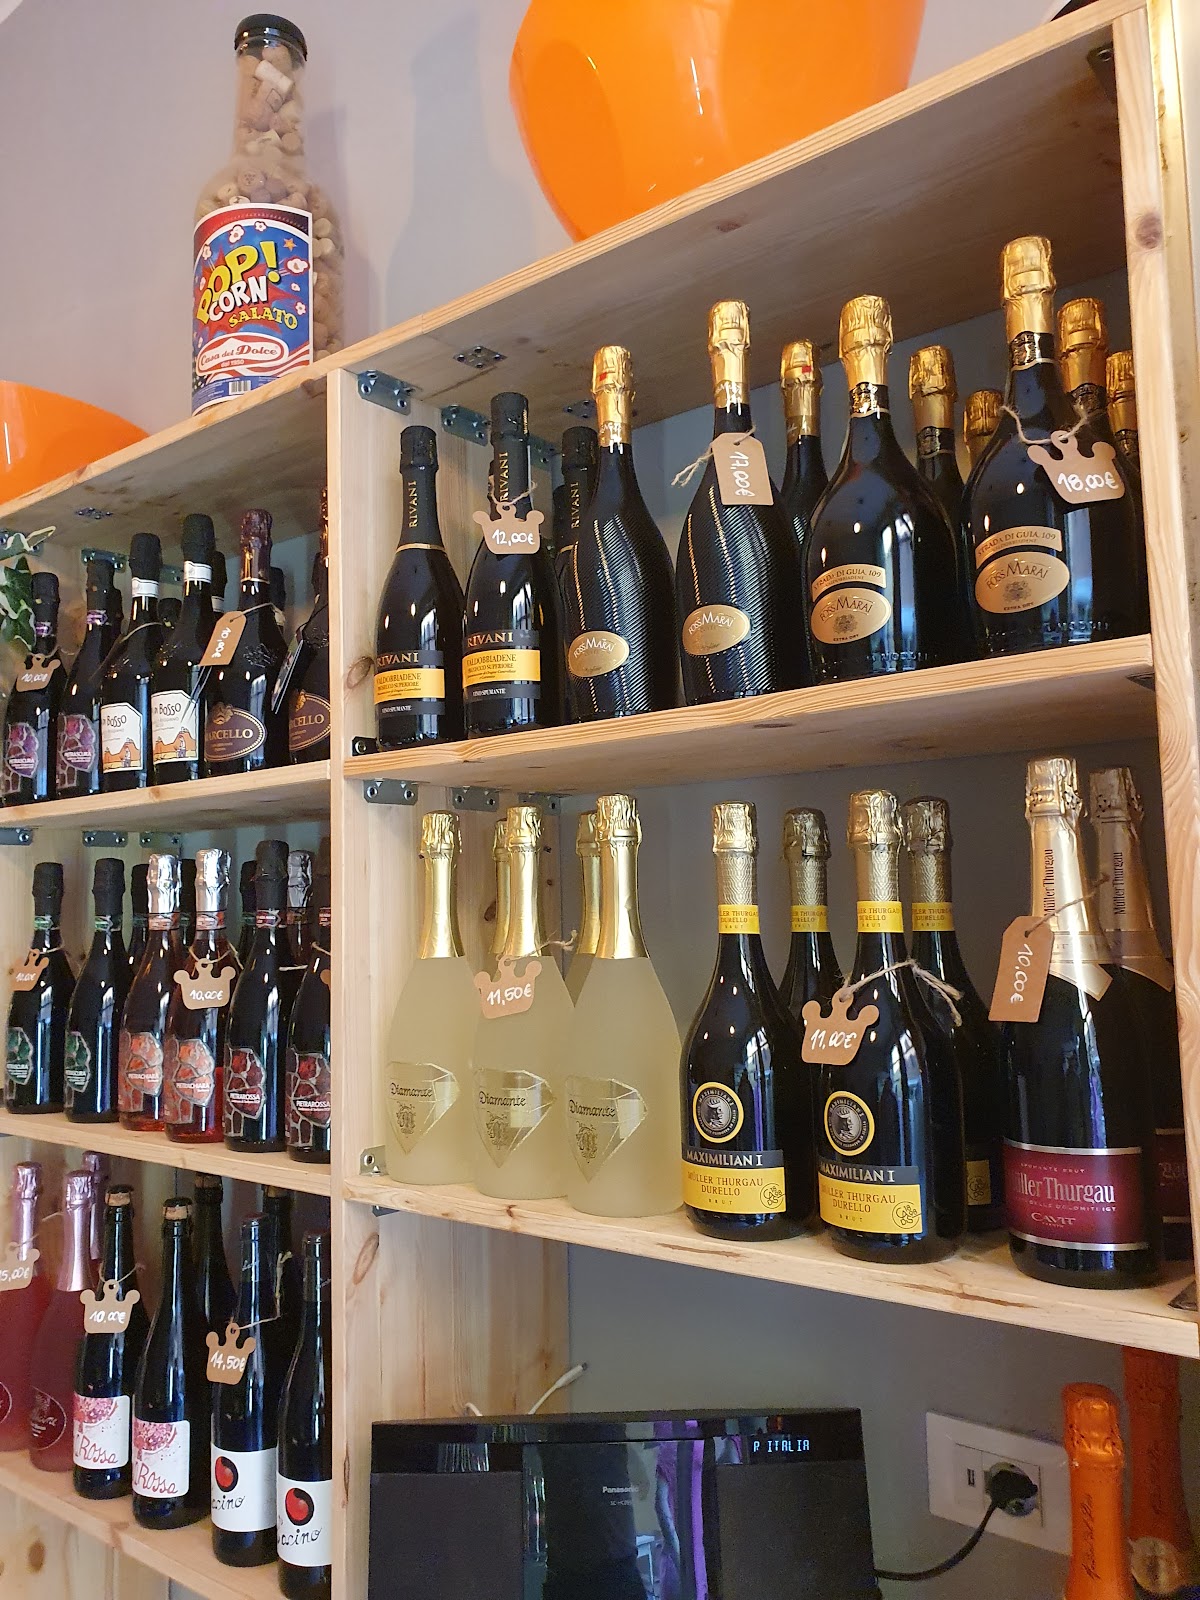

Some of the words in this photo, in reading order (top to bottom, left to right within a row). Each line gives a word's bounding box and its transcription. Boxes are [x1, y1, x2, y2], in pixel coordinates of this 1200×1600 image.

[196, 240, 281, 325] POP!
[208, 275, 269, 322] CORN
[228, 306, 299, 331] SALATO
[200, 354, 220, 367] Casa
[221, 349, 235, 359] del
[235, 344, 278, 356] Dolce
[499, 451, 509, 503] RIVANI
[407, 480, 418, 528] RIVANI
[570, 481, 580, 529] RIVANI
[1004, 532, 1014, 540] DI
[1041, 531, 1056, 541] 109
[836, 570, 846, 578] DI
[868, 569, 882, 579] 109
[467, 631, 514, 648] RIVANI
[376, 652, 420, 667] RIVANI
[1043, 849, 1055, 887] Thurgau
[1112, 852, 1124, 886] Thurgau
[486, 982, 533, 1007] 11,50€
[389, 1082, 433, 1099] Diamante
[478, 1090, 527, 1108] Diamante
[568, 1098, 617, 1118] Diamante
[686, 1149, 753, 1167] MAXIMILIAN
[755, 1154, 763, 1166] I
[820, 1161, 885, 1183] MAXIMILIAN
[886, 1170, 895, 1183] I
[701, 1184, 741, 1197] DURELLO
[716, 1176, 764, 1188] THURGAU
[1042, 1176, 1116, 1205] Thurgau
[832, 1198, 871, 1214] DURELLO
[846, 1191, 897, 1205] THURGAU
[0, 1266, 30, 1282] 5,00€
[767, 1439, 810, 1452] ITALIA
